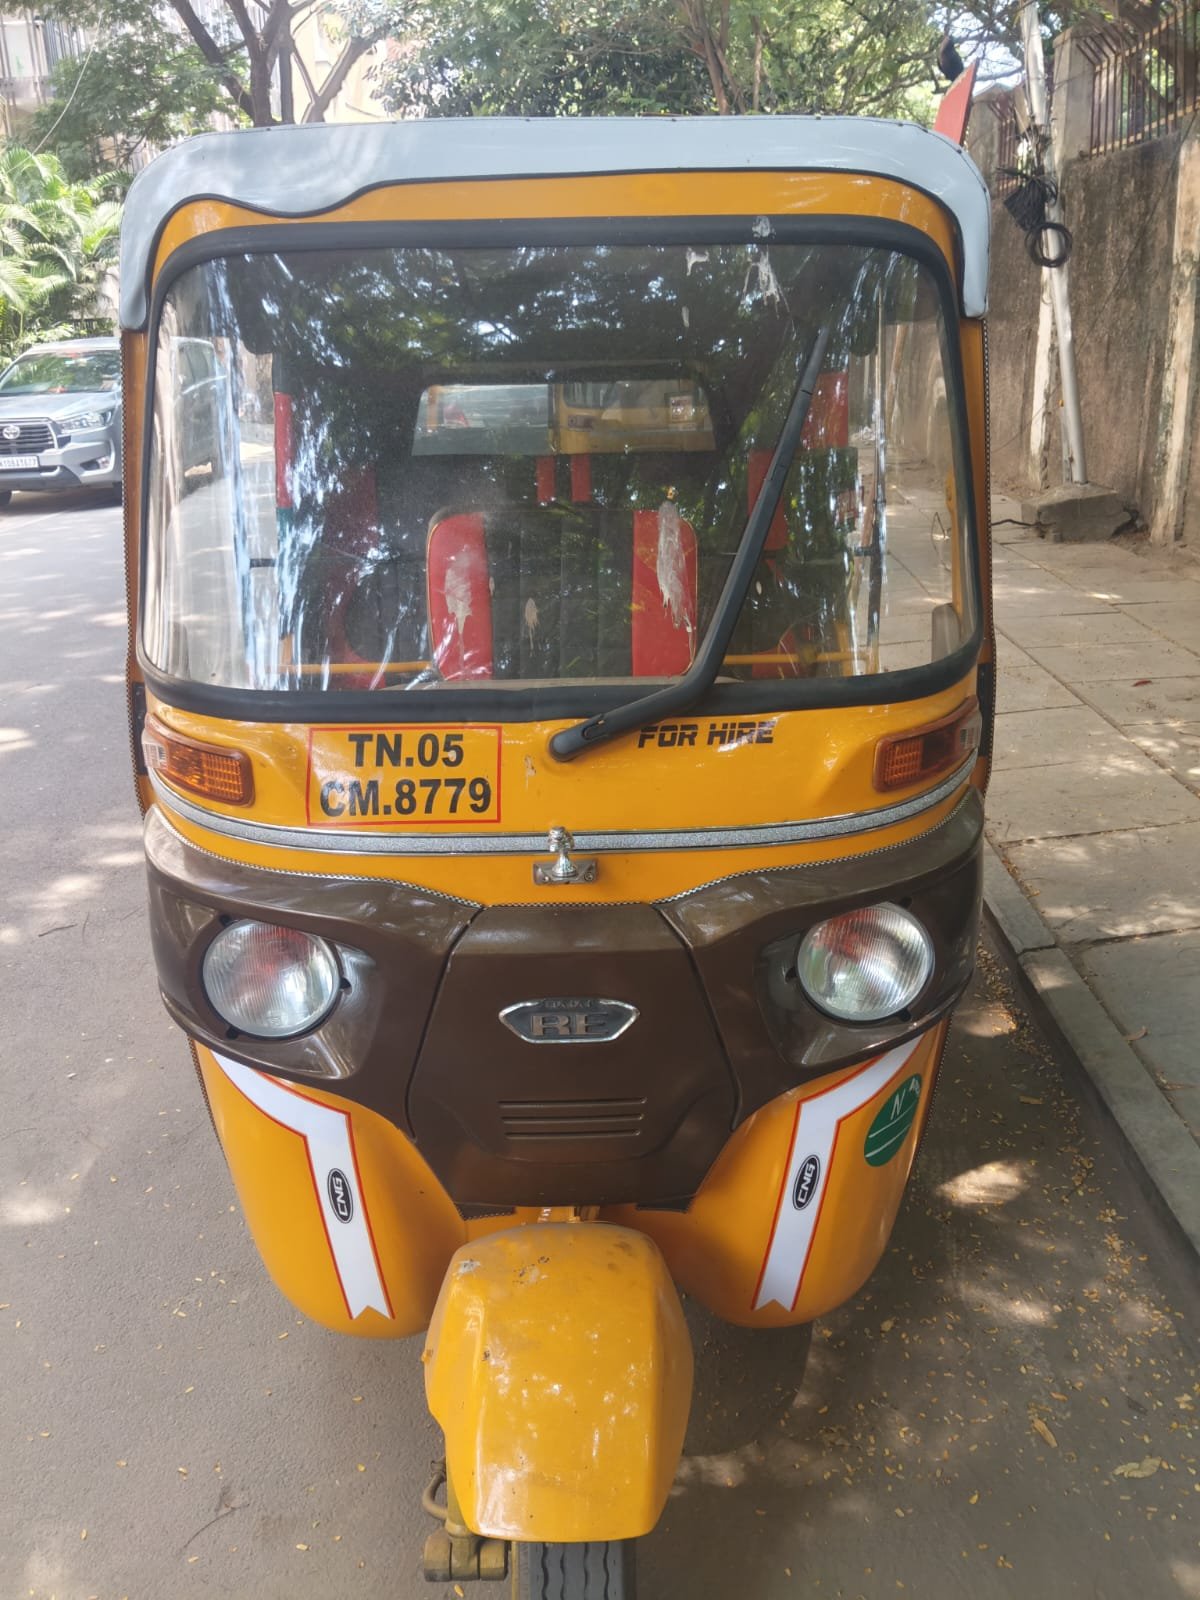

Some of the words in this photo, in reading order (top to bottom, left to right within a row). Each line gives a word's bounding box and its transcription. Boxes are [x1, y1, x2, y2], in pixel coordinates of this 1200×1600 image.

[348, 733, 464, 768] TN.05
[638, 724, 698, 748] FOR
[707, 721, 777, 746] HIRE
[320, 777, 492, 817] CM.8779
[531, 1012, 609, 1036] RE
[332, 1176, 348, 1217] CNG
[797, 1162, 816, 1204] CNG
